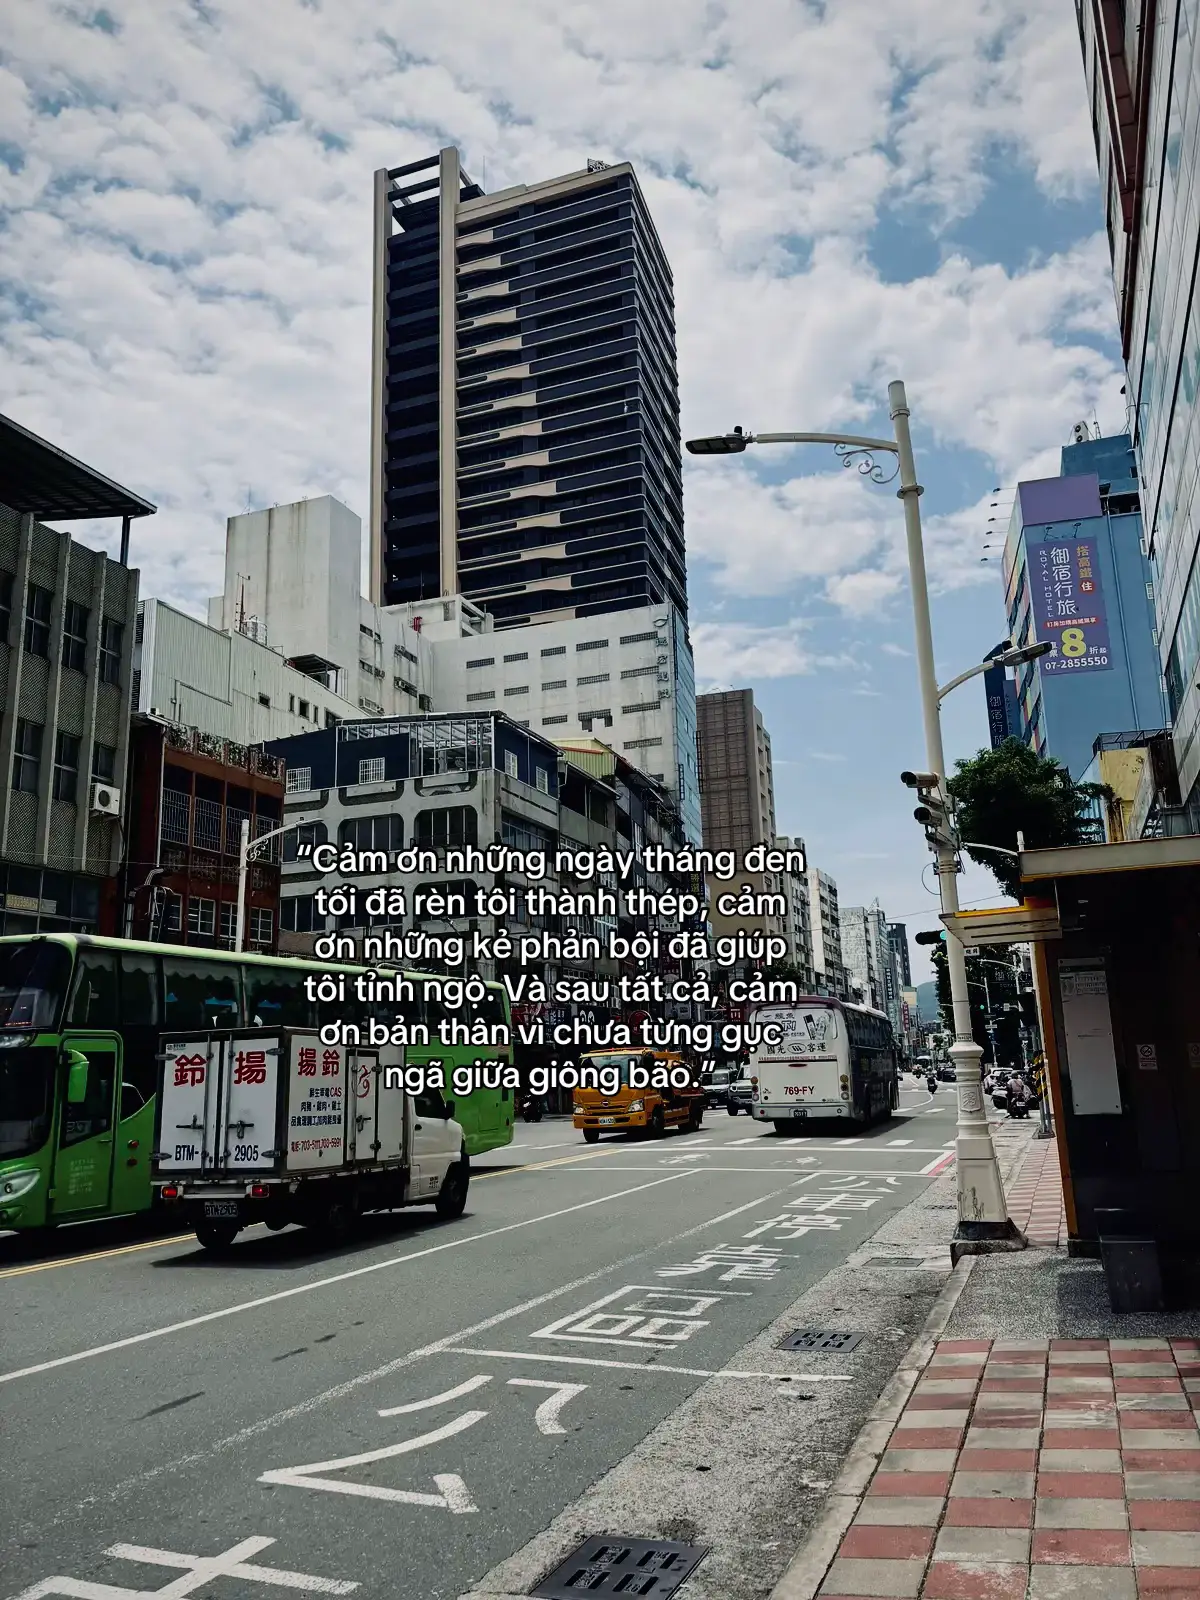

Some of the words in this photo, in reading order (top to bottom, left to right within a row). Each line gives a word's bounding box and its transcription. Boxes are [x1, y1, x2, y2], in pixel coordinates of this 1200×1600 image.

[1039, 549, 1049, 582] ROYAL
[1044, 585, 1054, 618] HOTEL
[1050, 547, 1077, 616] 御宿行旅
[1081, 581, 1093, 592] 住
[1061, 627, 1087, 657] 8
[1045, 656, 1108, 670] 07-2855550
[767, 1044, 786, 1055] 國光
[807, 1042, 827, 1053] 客運
[173, 1053, 208, 1087] 鈴
[233, 1050, 267, 1086] 揚
[783, 1086, 815, 1096] 769-FY
[234, 1144, 260, 1162] 2905
[528, 1175, 903, 1350] 公車停靠區
